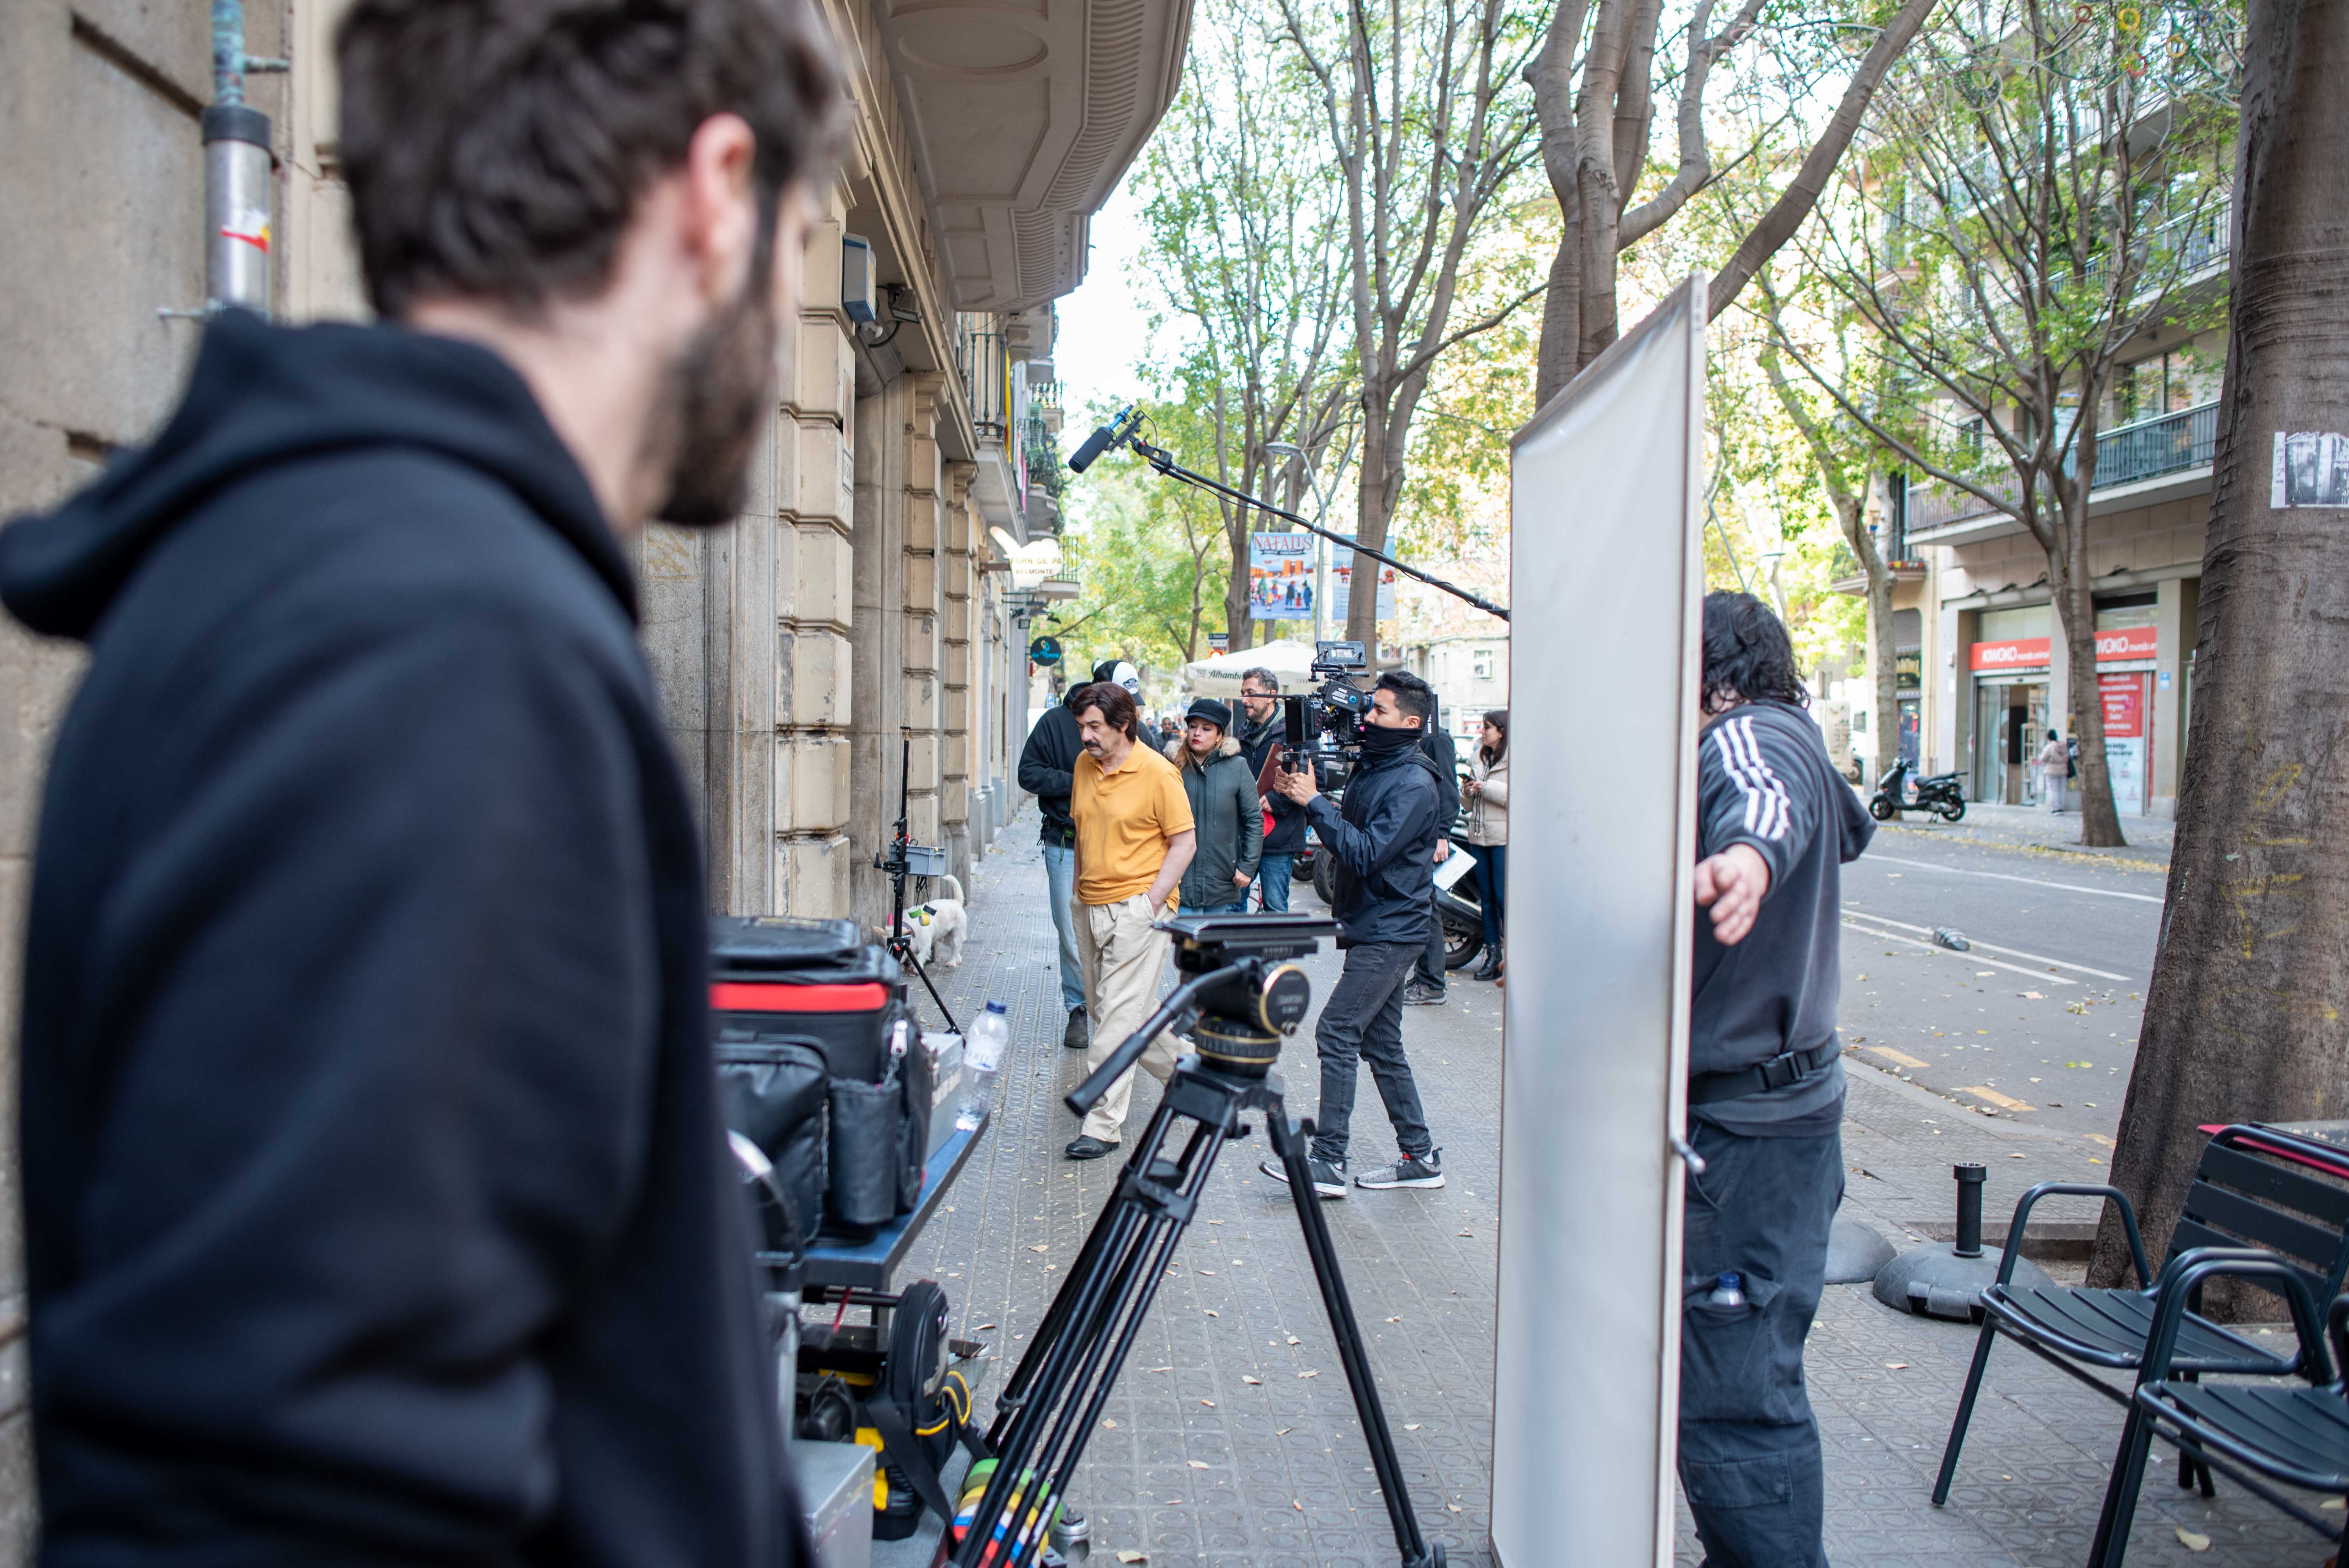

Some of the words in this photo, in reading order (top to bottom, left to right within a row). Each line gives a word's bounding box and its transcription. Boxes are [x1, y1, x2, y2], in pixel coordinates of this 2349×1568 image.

[2097, 636, 2129, 654] WOKO
[2129, 640, 2149, 652] mundo
[1982, 646, 2018, 663] KIWOKO
[2018, 652, 2034, 660] mundo
[1209, 669, 1242, 680] Alhambr
[1332, 690, 1346, 699] ARRI
